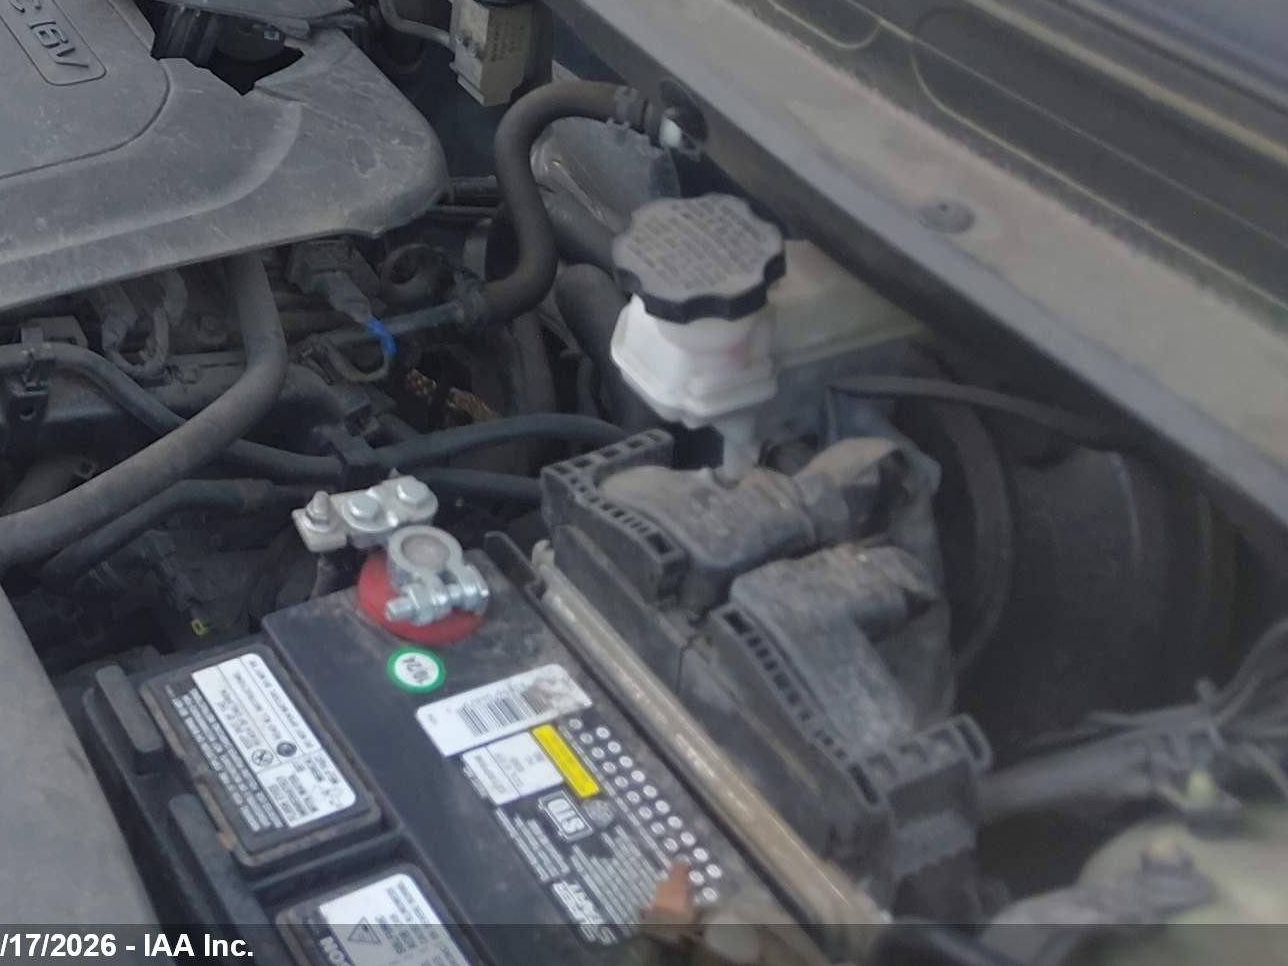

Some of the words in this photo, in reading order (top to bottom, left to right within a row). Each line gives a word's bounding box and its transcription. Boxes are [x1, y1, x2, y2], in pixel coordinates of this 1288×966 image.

[27, 20, 89, 69] 16V
[547, 798, 585, 833] STD
[562, 881, 618, 945] START
